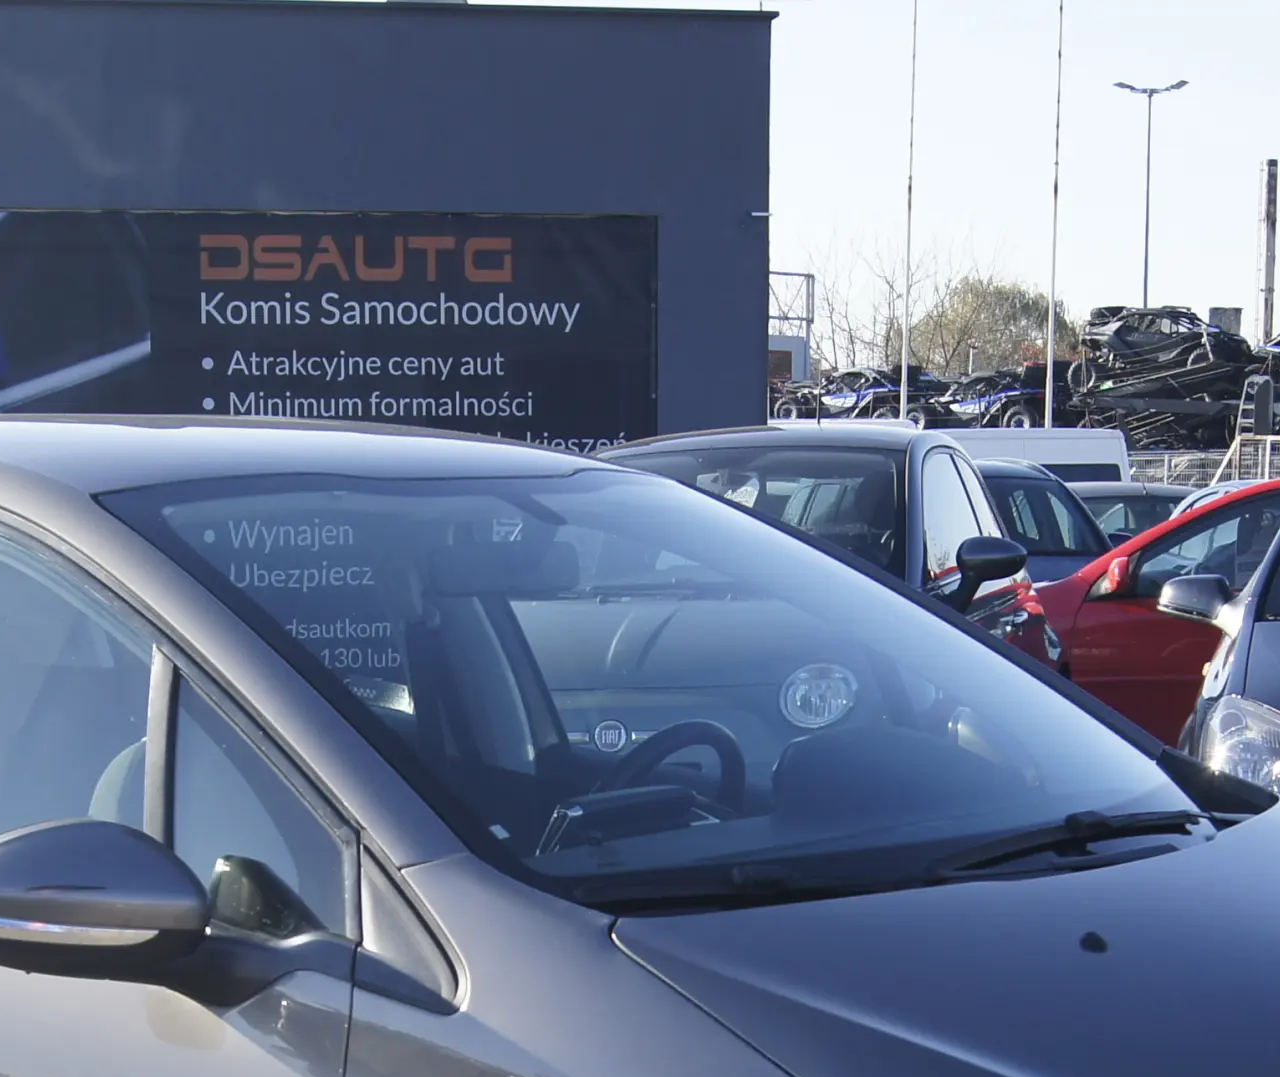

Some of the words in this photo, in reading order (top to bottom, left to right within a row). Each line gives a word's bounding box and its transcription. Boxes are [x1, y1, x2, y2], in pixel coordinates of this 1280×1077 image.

[200, 292, 311, 326] Komis
[320, 292, 581, 333] Samochodowy
[227, 349, 381, 381] Atrakcyjne
[388, 357, 453, 381] ceny
[460, 353, 505, 376] aut
[229, 392, 362, 419] Minimum
[369, 390, 534, 418] formalności
[229, 561, 375, 592] Ubezpiecz
[321, 648, 362, 668] 130
[368, 648, 401, 668] lub
[602, 730, 620, 744] FIAT
